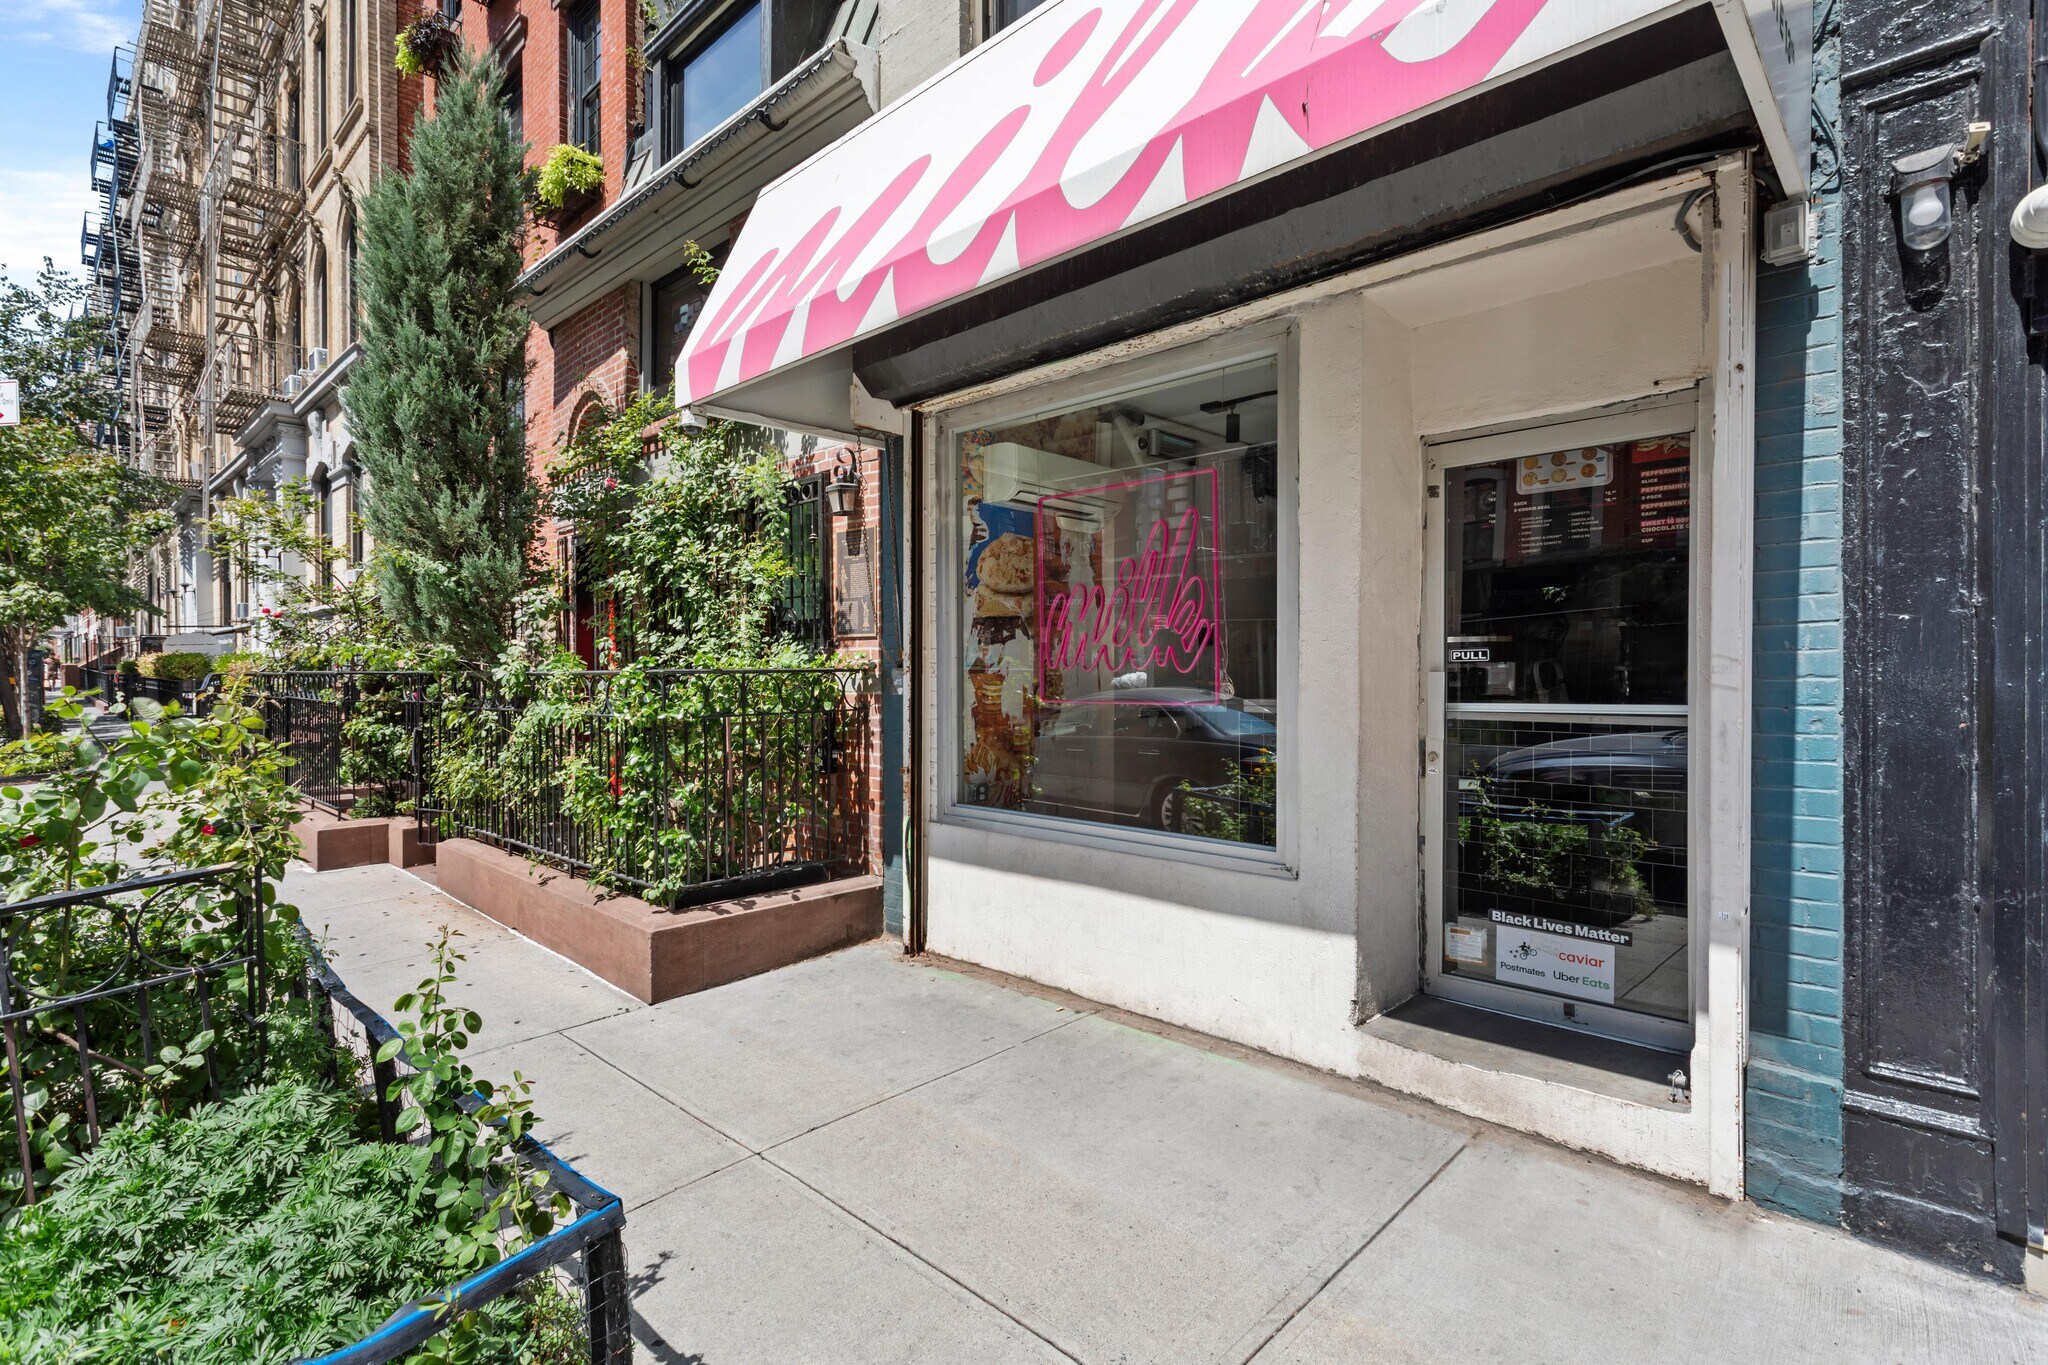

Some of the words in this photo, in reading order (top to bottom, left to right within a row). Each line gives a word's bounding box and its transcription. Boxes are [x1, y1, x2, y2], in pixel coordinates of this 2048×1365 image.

[1641, 466, 1687, 477] PEPPERMINT
[1641, 483, 1687, 493] PEPPERMINT
[1641, 500, 1687, 510] PEPPERMINT
[1641, 519, 1665, 527] SWEET
[1641, 524, 1685, 533] CHOCOLATE
[1046, 506, 1213, 674] milk
[1453, 651, 1487, 660] PULL
[1491, 910, 1531, 928] Black
[1533, 918, 1573, 935] Lives
[1575, 924, 1629, 944] Matter
[1558, 952, 1605, 968] caviar
[1500, 961, 1546, 978] Postmates
[1553, 970, 1580, 984] Uber
[1582, 976, 1610, 990] Eats
